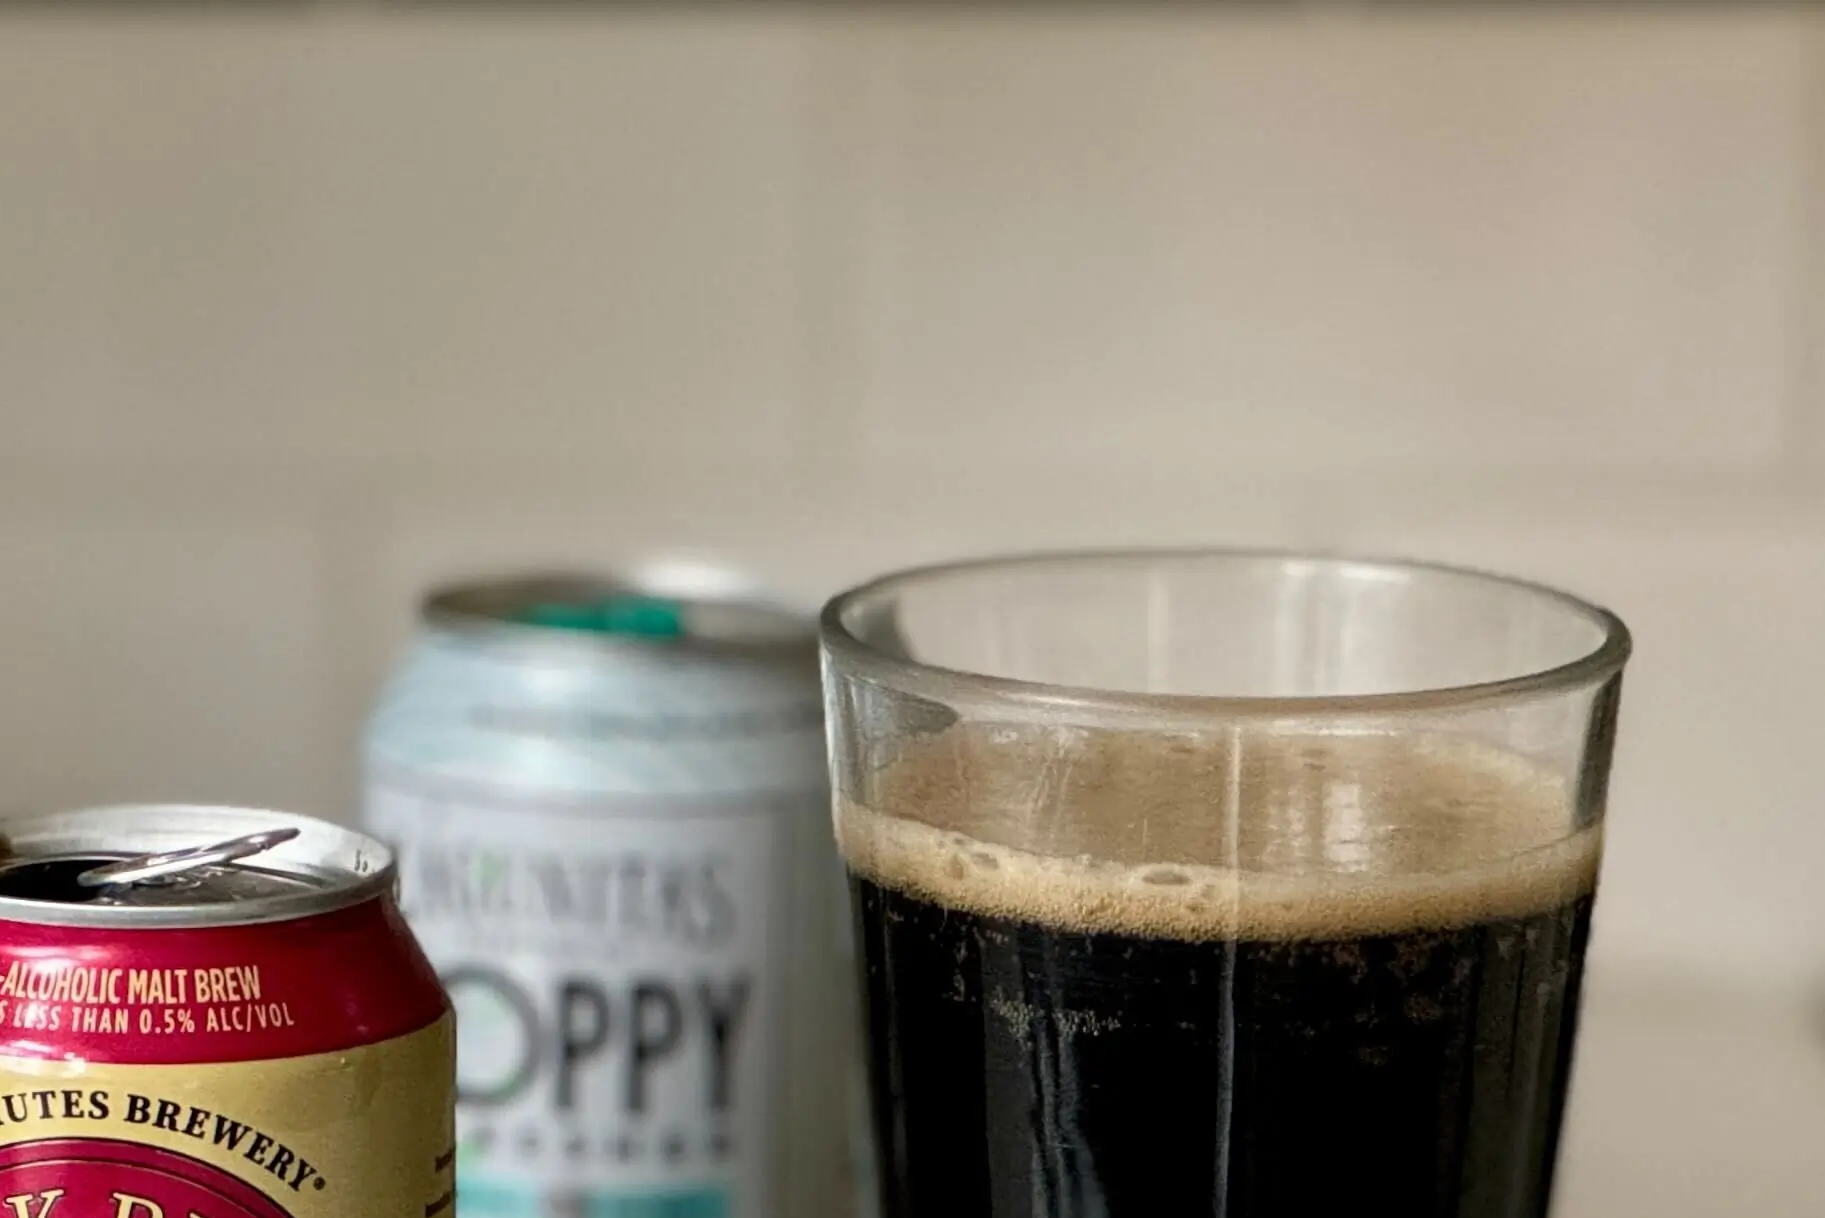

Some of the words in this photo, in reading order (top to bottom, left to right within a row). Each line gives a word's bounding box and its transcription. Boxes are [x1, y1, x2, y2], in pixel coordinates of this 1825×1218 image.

[127, 968, 187, 1005] MALT
[194, 964, 261, 1004] BREW
[12, 1000, 62, 1032] LESS
[71, 1007, 129, 1034] THAN
[139, 1007, 196, 1035] 0.5%
[206, 1001, 296, 1033] ALC/VOL
[440, 965, 753, 1114] OPPY
